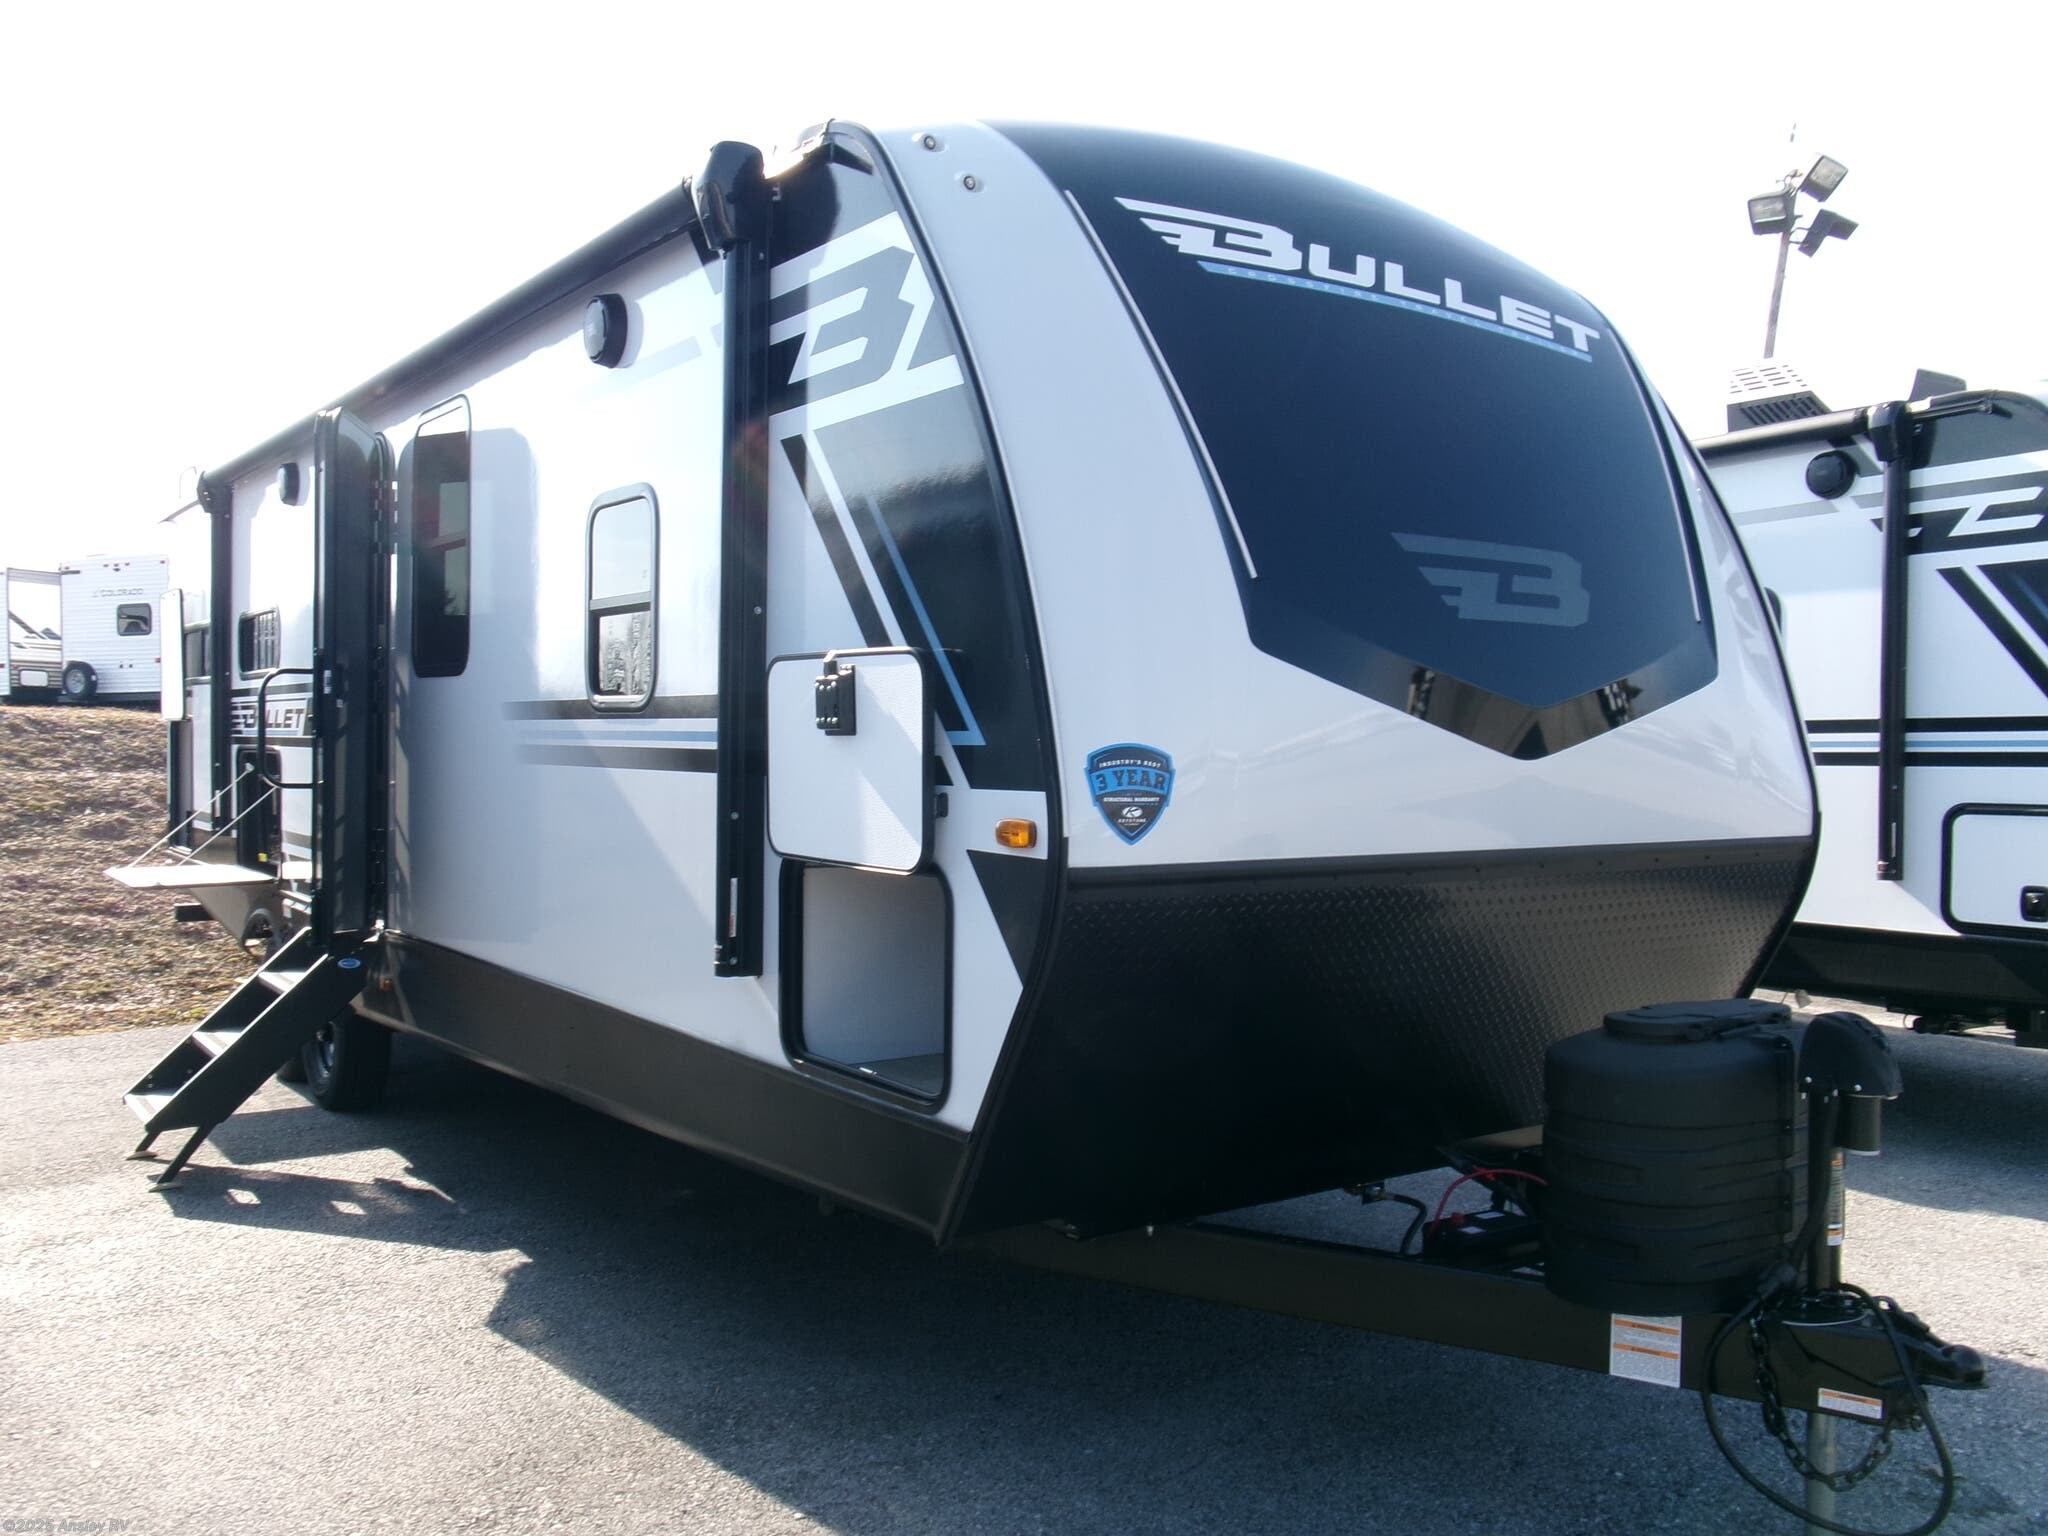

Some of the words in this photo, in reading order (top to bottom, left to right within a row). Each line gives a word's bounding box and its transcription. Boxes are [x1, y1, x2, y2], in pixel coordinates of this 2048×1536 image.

[1114, 197, 1600, 353] BULLET
[232, 704, 305, 729] BLLET
[1096, 774, 1107, 790] 3
[1112, 769, 1165, 789] YEAR
